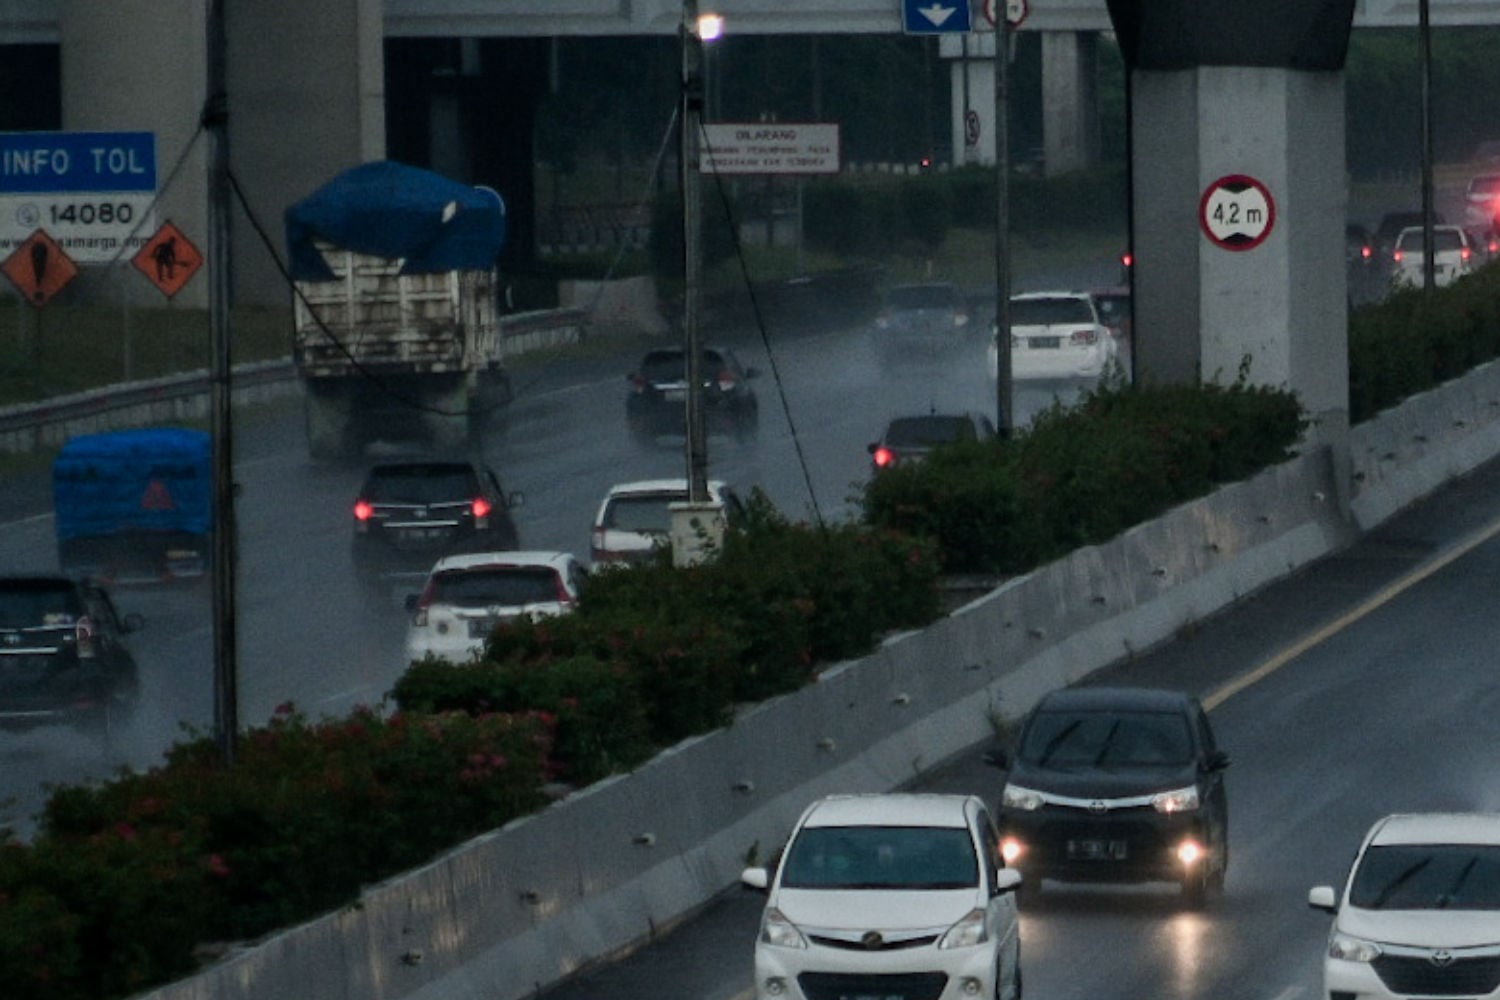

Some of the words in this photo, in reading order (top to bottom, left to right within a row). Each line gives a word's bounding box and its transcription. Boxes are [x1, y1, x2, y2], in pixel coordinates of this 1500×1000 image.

[3, 148, 70, 175] INFO
[90, 147, 146, 174] TOL
[51, 203, 133, 224] 14080
[1246, 208, 1262, 224] m
